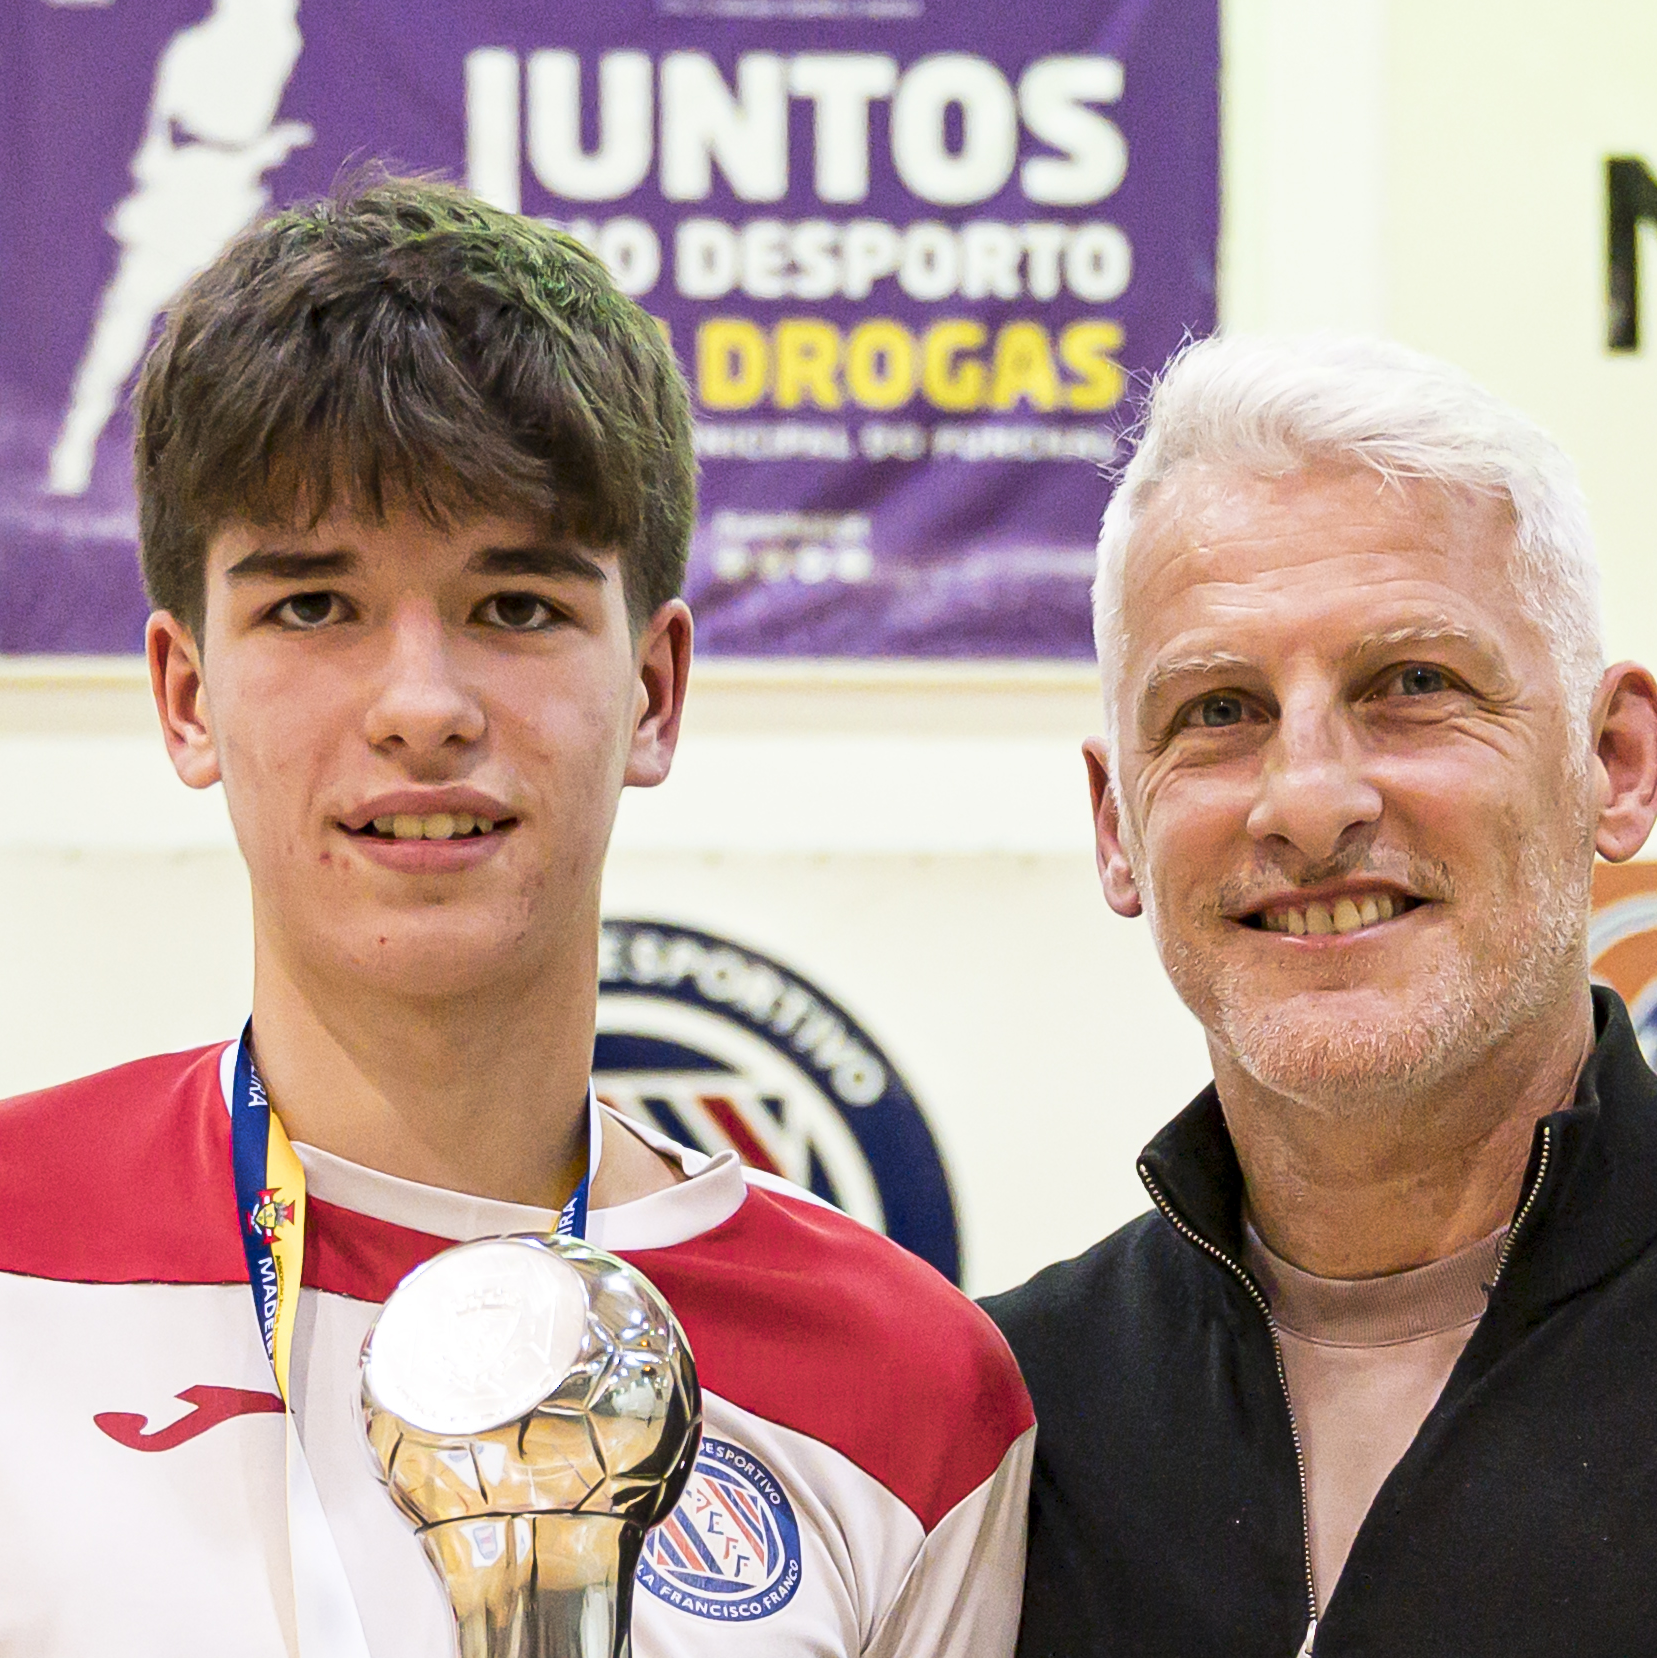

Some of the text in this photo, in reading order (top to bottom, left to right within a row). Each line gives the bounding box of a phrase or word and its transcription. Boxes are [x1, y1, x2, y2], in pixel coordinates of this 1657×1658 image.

[465, 47, 1128, 215] JUNTOS
[674, 217, 1132, 299] DESPORTO
[697, 316, 1126, 412] DROGAS
[598, 930, 888, 1106] ESPORTIVO
[659, 1585, 762, 1619] FRANCISCO
[762, 1558, 800, 1611] FRANCO
